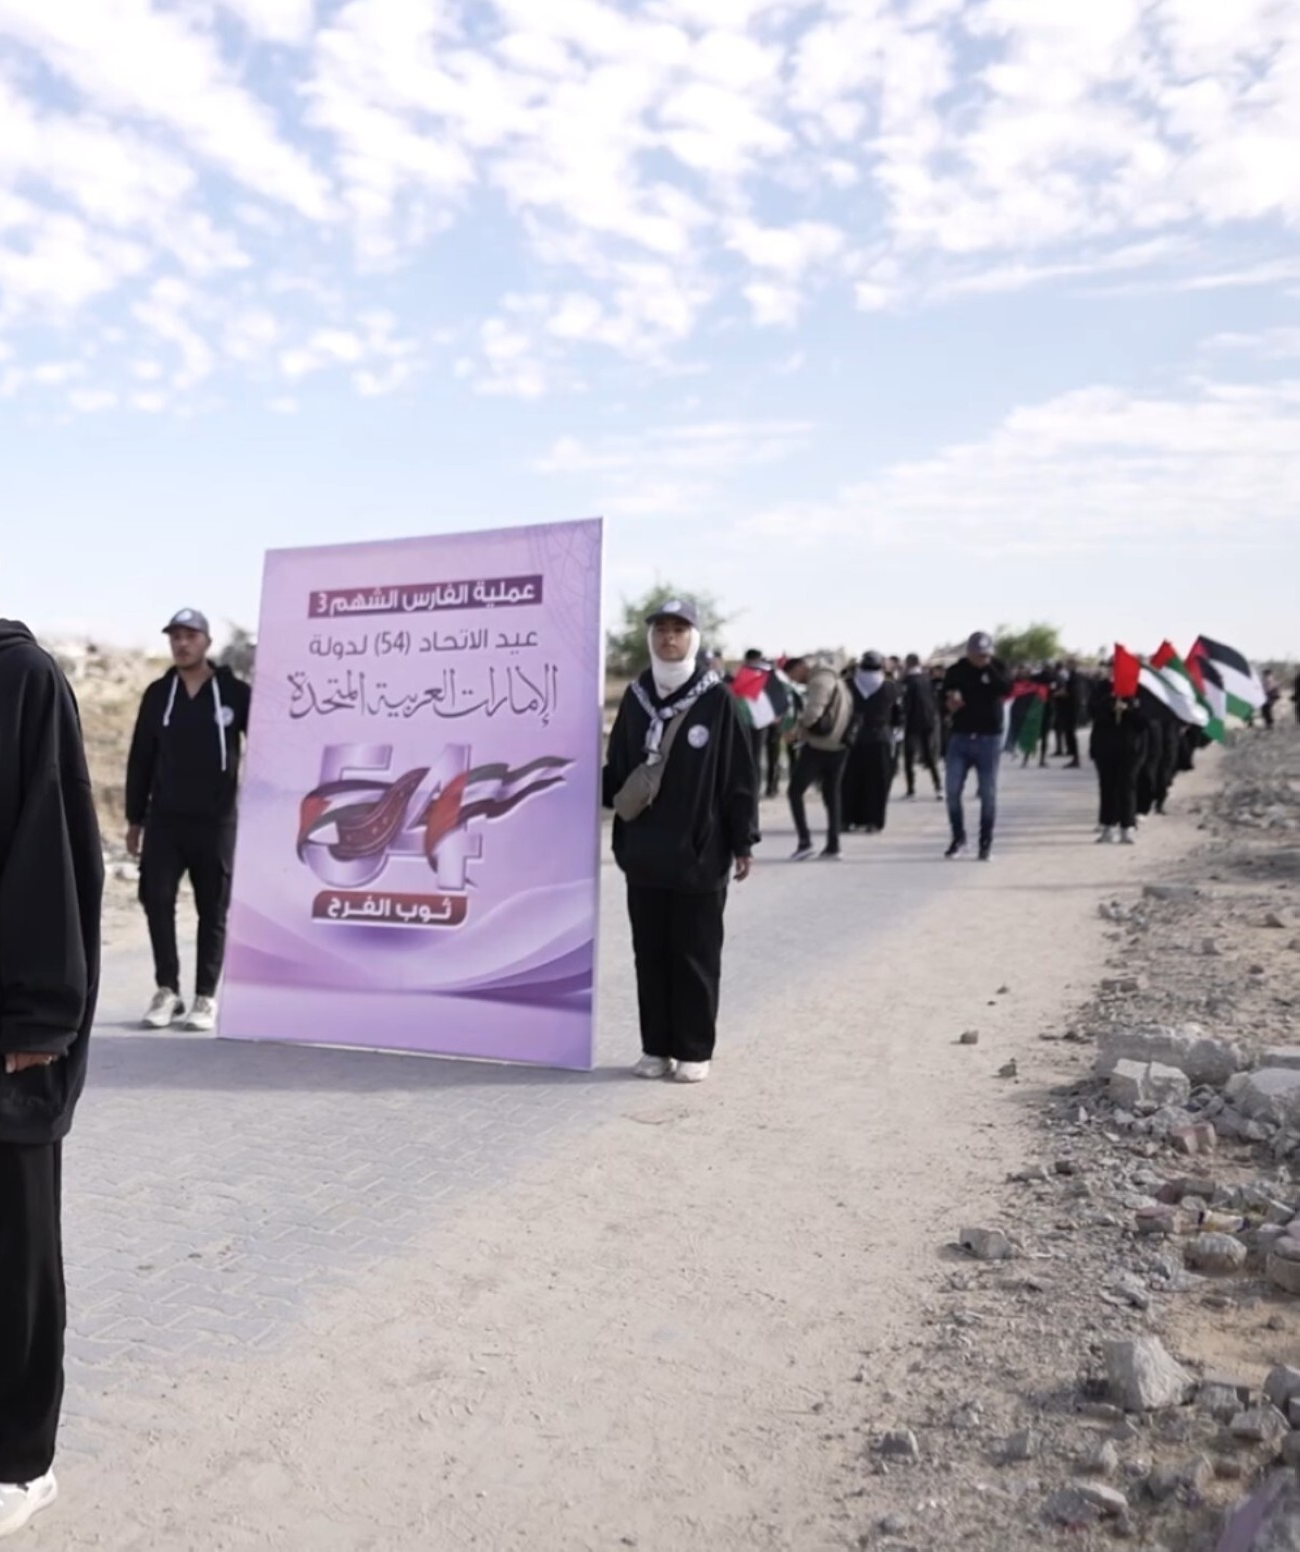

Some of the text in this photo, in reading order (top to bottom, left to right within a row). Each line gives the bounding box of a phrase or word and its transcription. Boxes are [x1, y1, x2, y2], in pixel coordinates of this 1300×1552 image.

[317, 581, 534, 616] عملية الفارس الشهم 3
[309, 629, 538, 660] عيد الاتحاد (54) لدولة
[288, 664, 558, 727] الإمارات العربية المتحدة
[327, 897, 451, 922] ثوب الفرح
